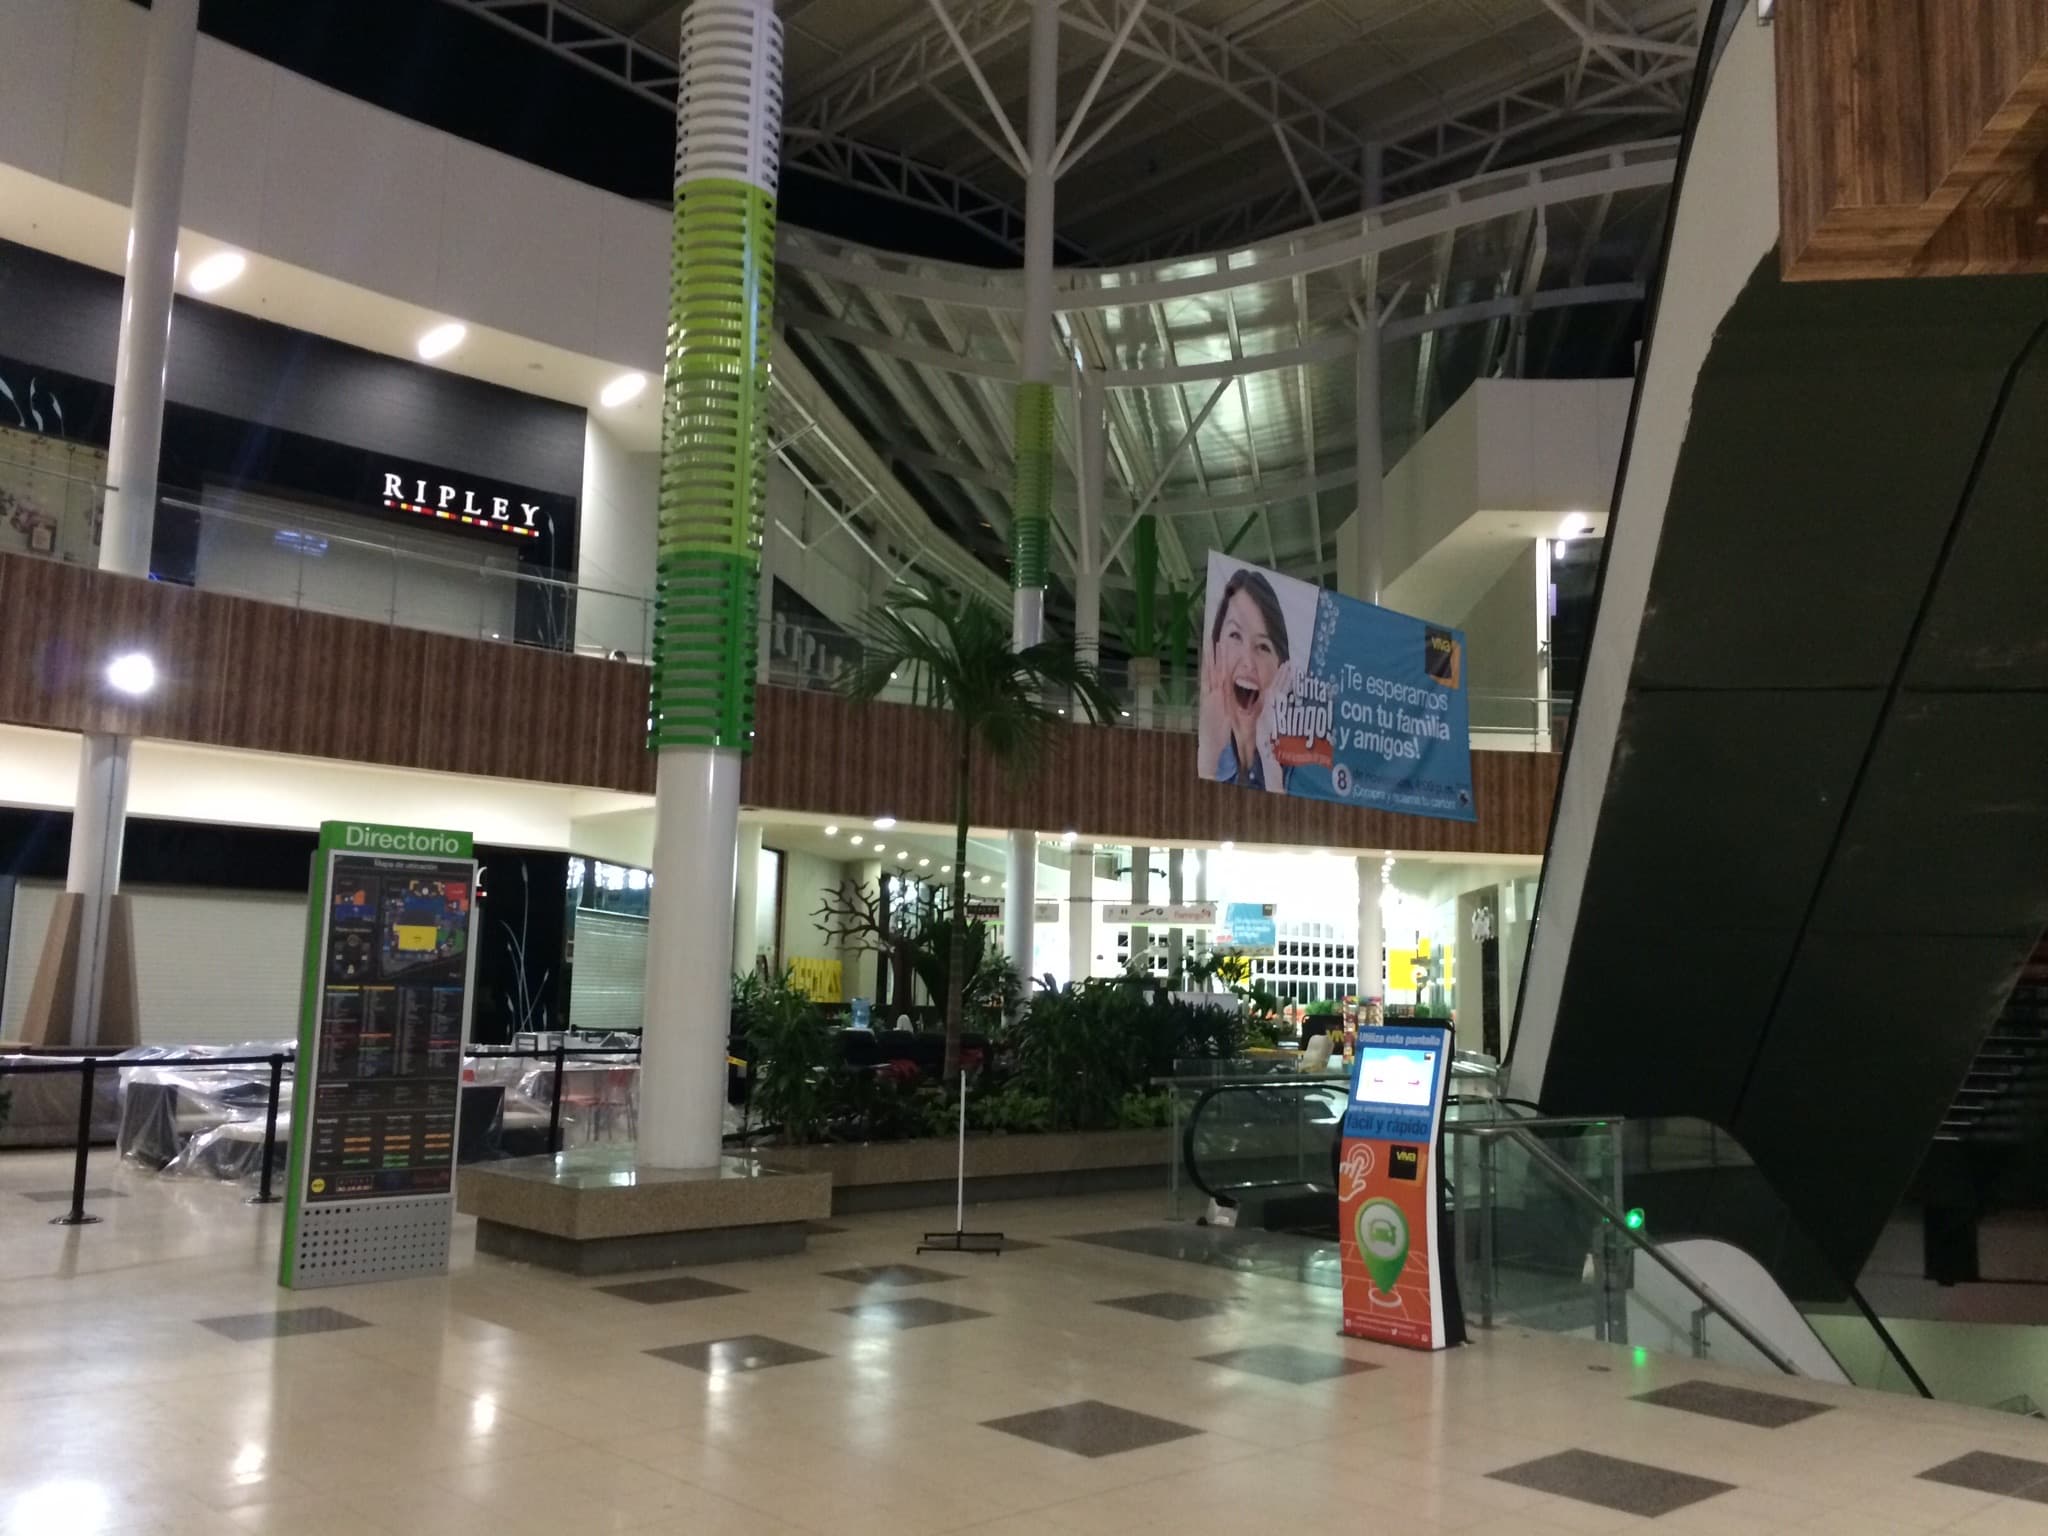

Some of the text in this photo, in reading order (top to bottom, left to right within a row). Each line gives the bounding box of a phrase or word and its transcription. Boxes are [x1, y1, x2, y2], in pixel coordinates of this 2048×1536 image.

[383, 473, 540, 526] RIPLEY
[1340, 663, 1448, 711] ¡Te esperamos
[1271, 690, 1334, 749] ¡Bingo!
[1341, 700, 1450, 740] con tu familia
[1339, 726, 1350, 750] y
[1353, 729, 1420, 761] amigos!
[1337, 769, 1347, 791] 8
[345, 826, 459, 853] Directorio
[1359, 1032, 1384, 1043] Utiliza
[1405, 1035, 1440, 1047] pantalla
[1376, 1119, 1384, 1133] y
[1386, 1119, 1428, 1136] rápido
